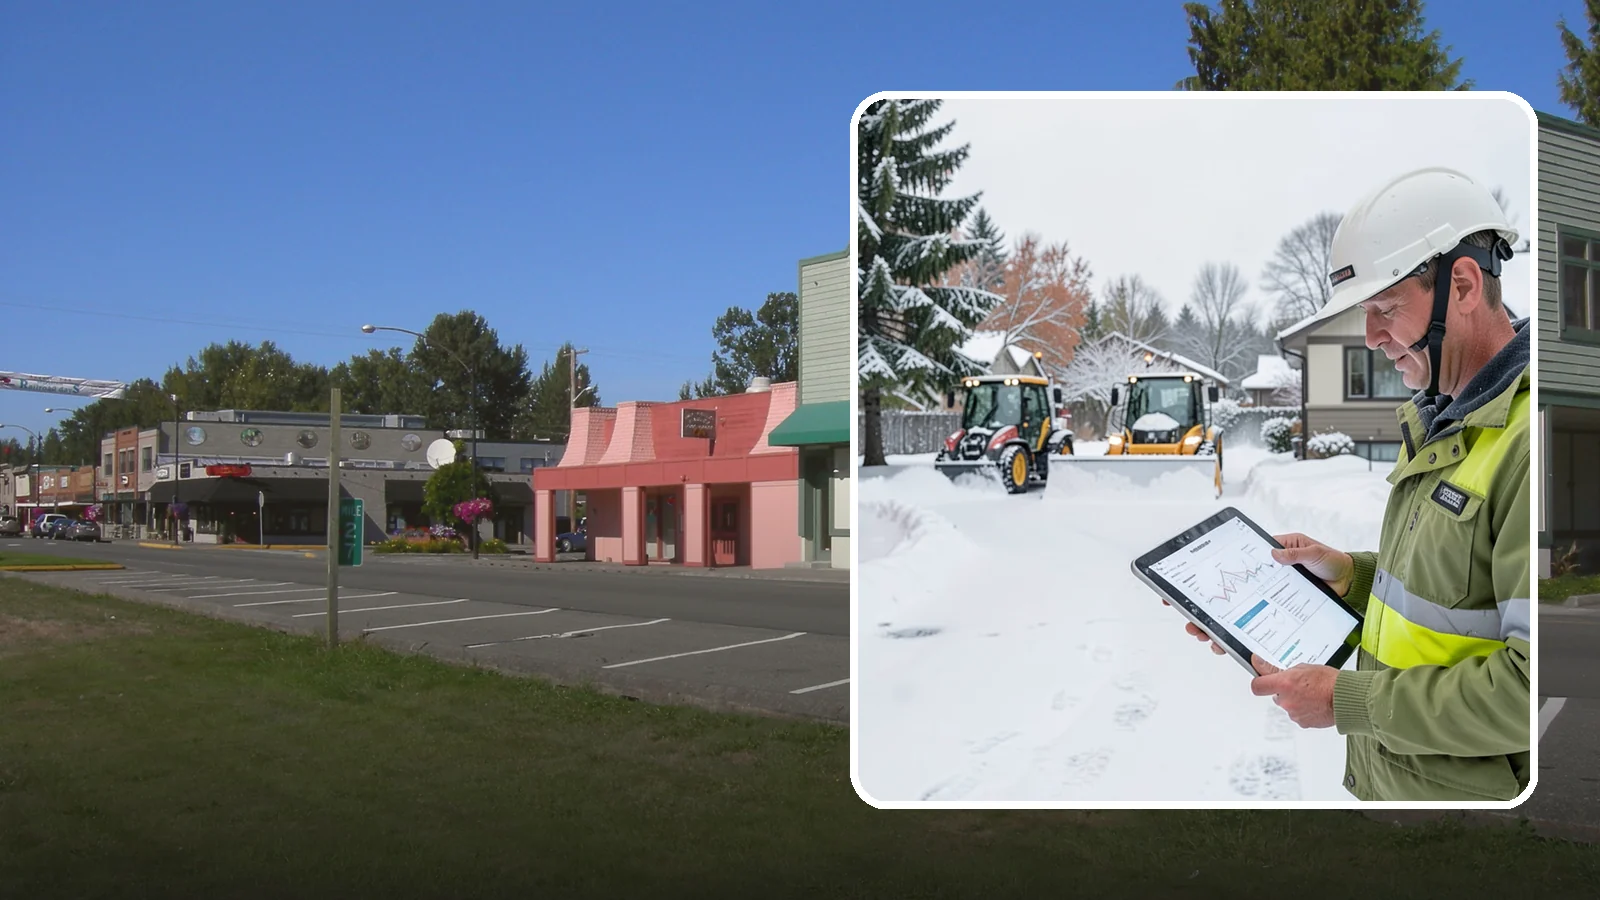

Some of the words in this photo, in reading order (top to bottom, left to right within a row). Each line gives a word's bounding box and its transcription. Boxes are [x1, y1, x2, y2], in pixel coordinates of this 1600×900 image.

[20, 379, 57, 392] Railroad
[340, 505, 361, 517] MILE
[344, 522, 357, 539] 2
[343, 542, 356, 559] 7
